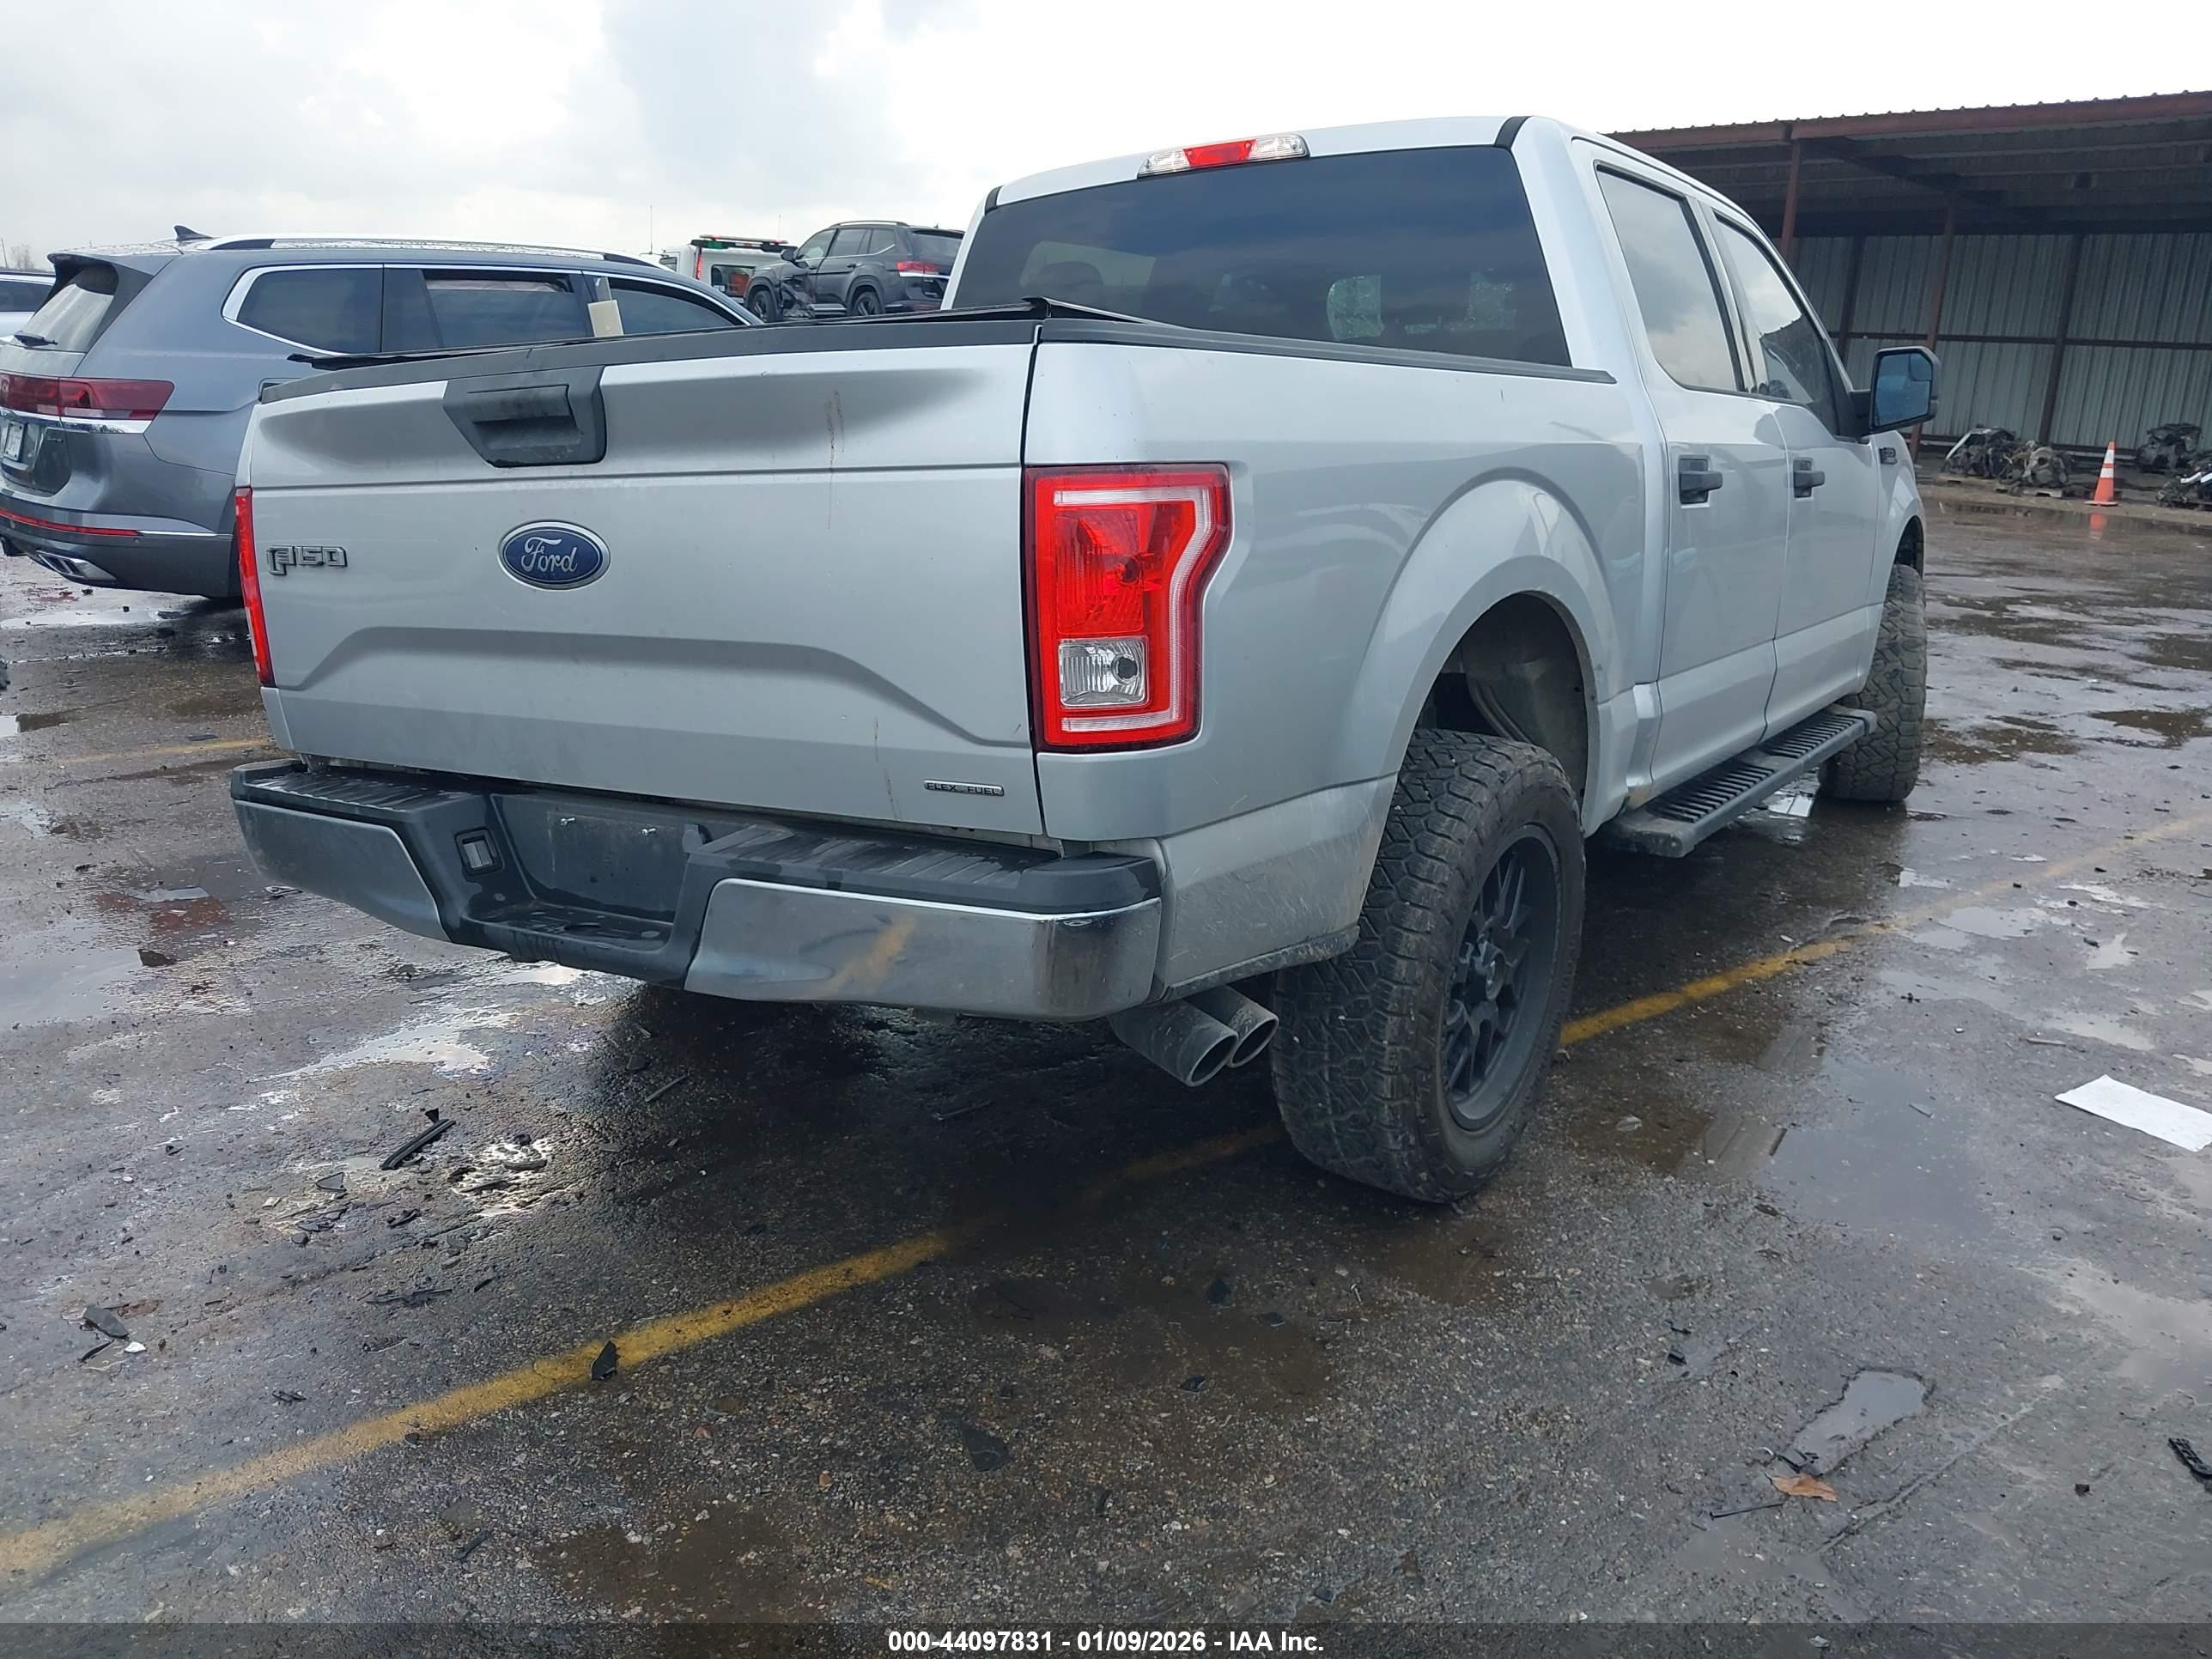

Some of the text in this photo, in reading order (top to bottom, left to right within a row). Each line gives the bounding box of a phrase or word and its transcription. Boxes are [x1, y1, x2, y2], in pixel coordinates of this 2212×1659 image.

[520, 536, 578, 572] Ford
[927, 781, 1000, 796] FLEX FUEL
